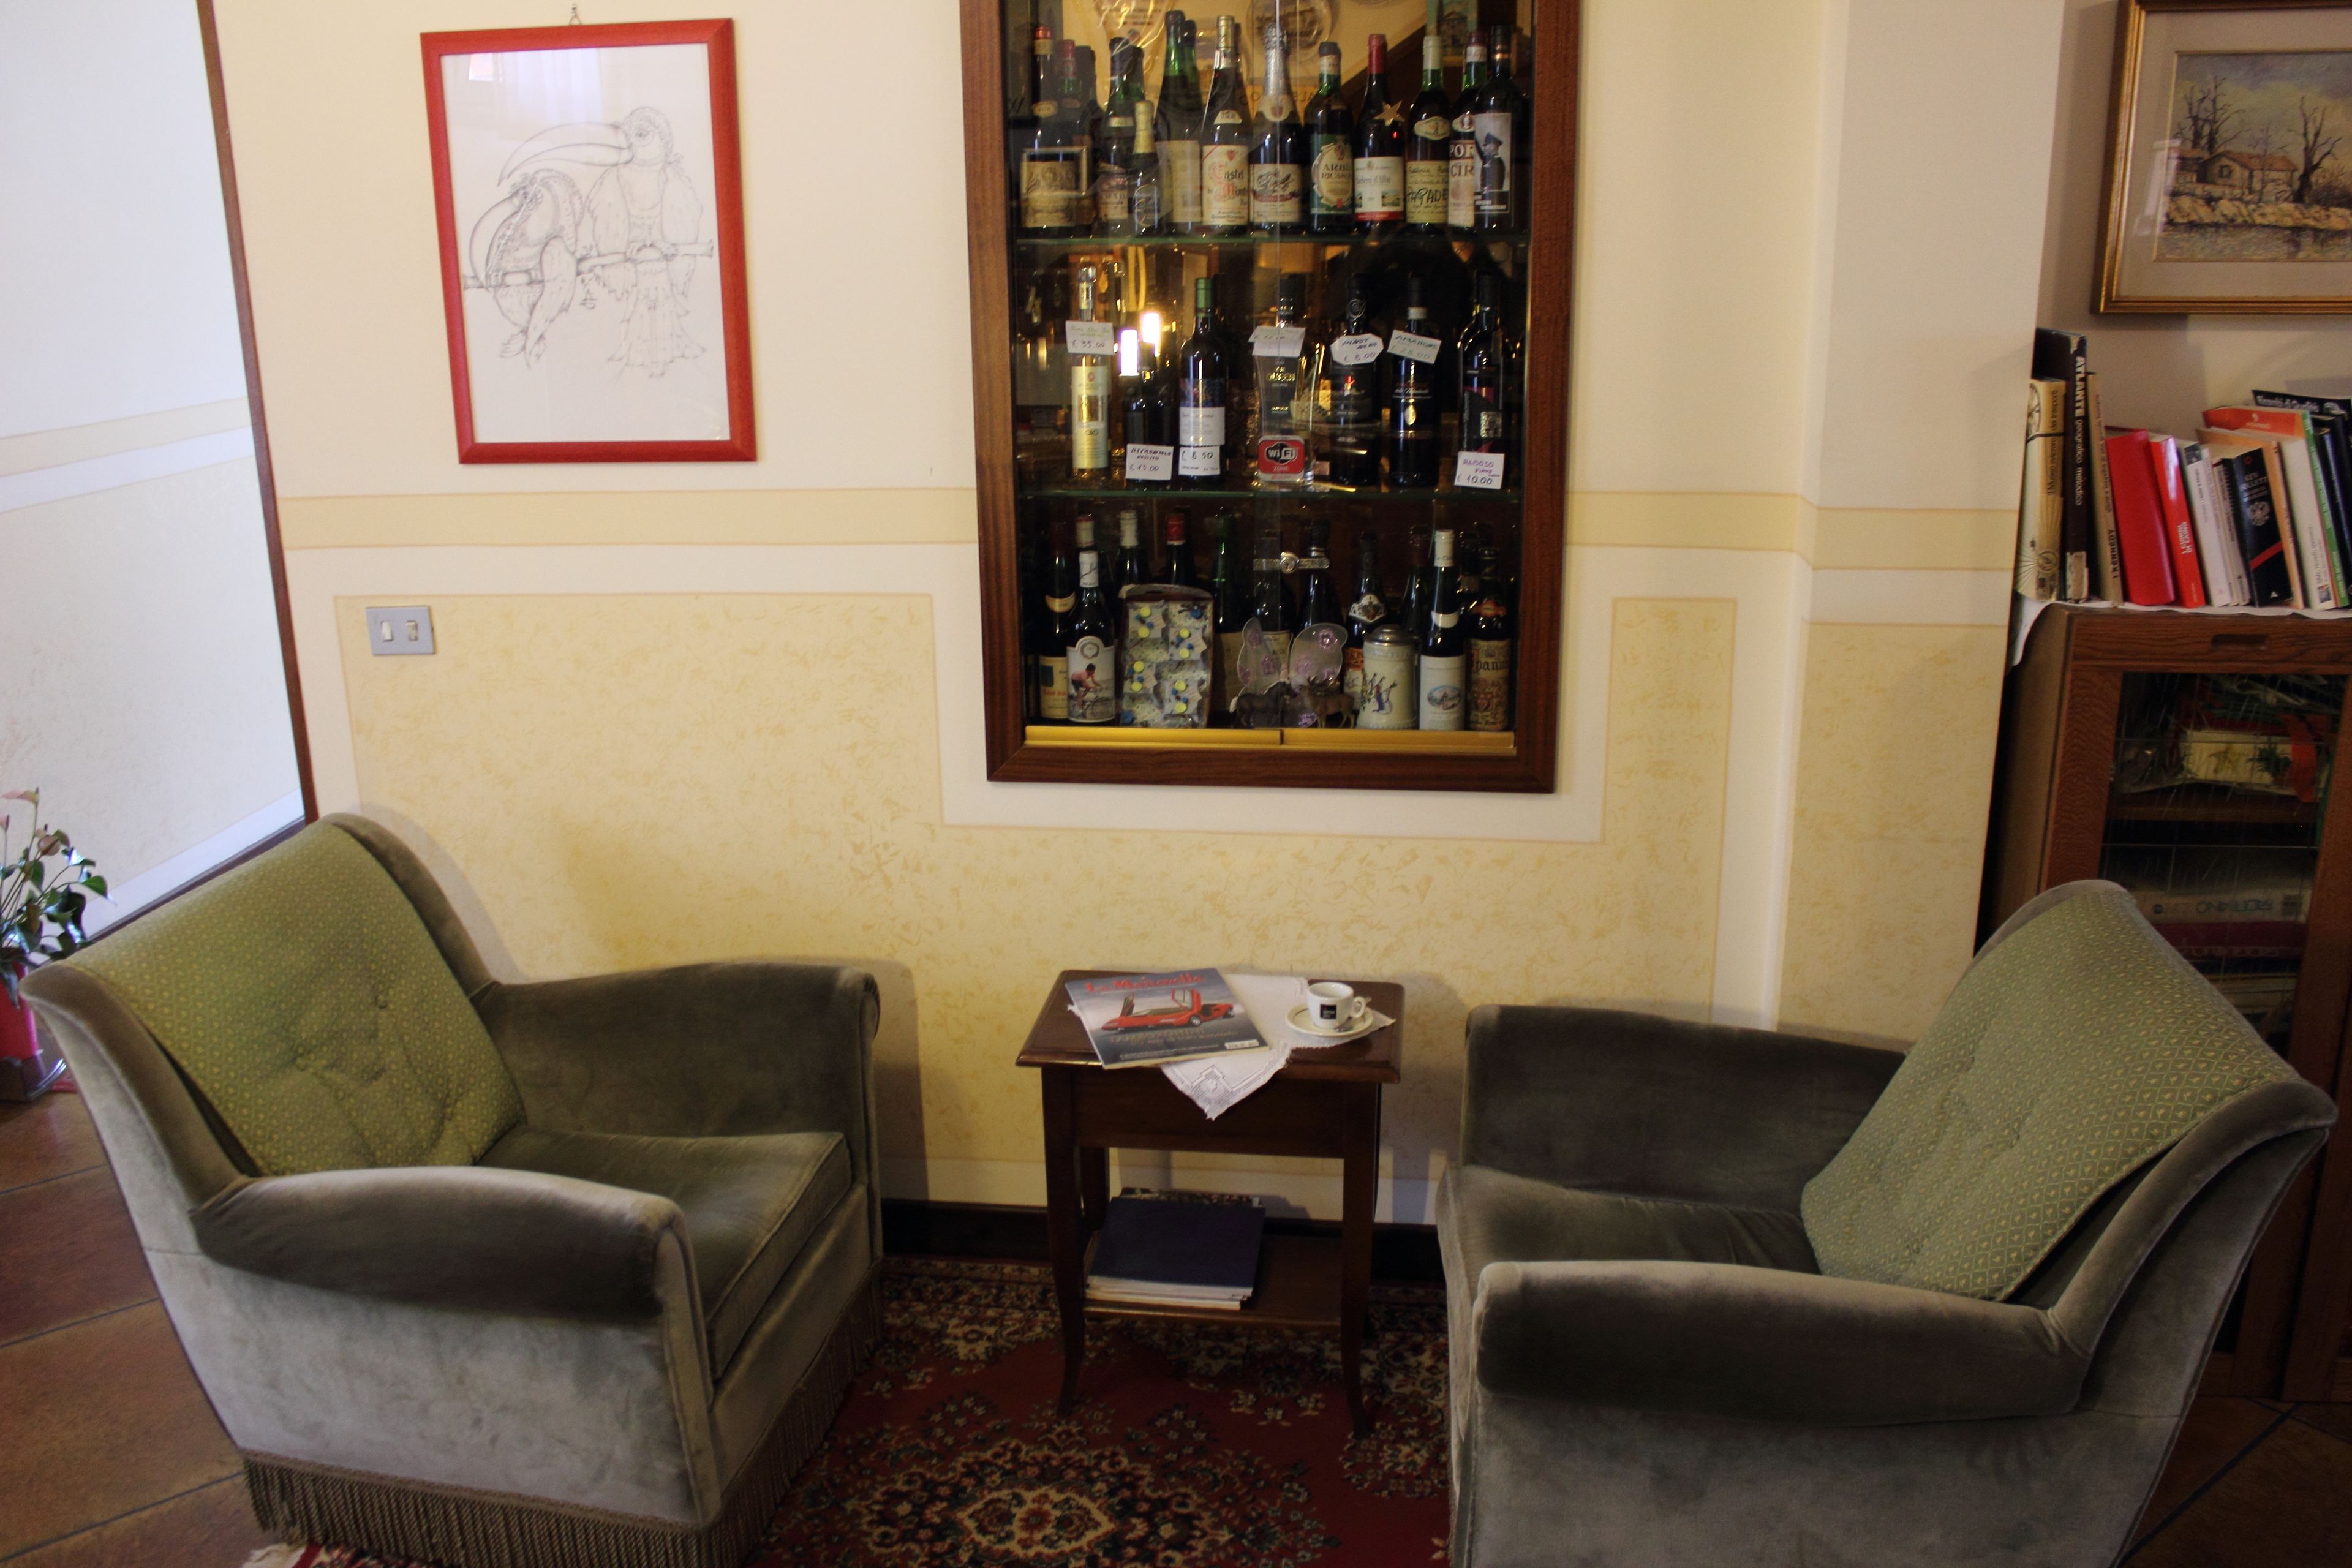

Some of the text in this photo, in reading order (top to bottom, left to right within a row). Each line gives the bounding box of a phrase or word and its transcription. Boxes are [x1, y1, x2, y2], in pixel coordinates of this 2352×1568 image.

[2075, 356, 2086, 506] ATLANTE geografico metodico
[2108, 529, 2119, 569] KENNEDY
